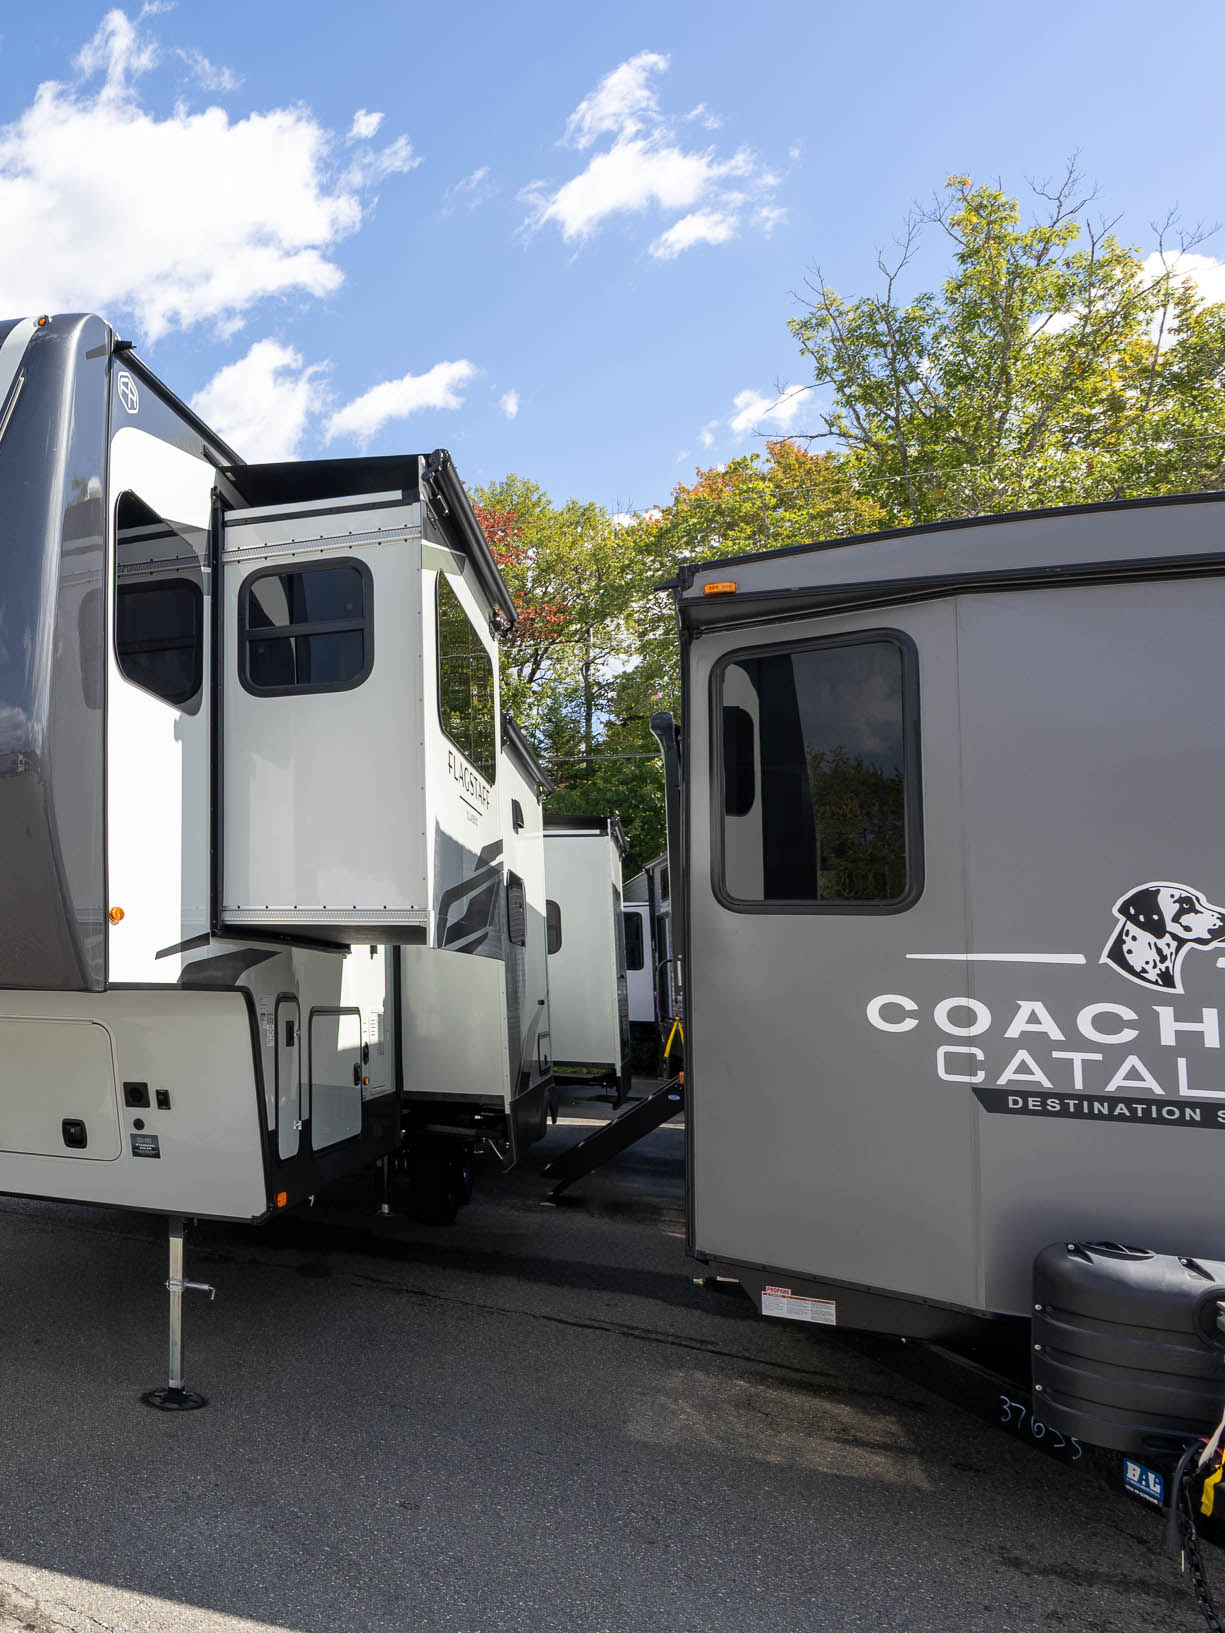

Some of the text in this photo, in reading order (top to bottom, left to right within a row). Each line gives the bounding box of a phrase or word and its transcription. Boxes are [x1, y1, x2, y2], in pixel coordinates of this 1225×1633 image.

[448, 750, 490, 810] FLAGSTAFF
[866, 994, 1221, 1048] COACH
[936, 1045, 1225, 1099] CATAL
[1007, 1096, 1202, 1121] DESTINATION
[767, 1287, 790, 1295] PROPANE
[1126, 1460, 1161, 1494] BAL
